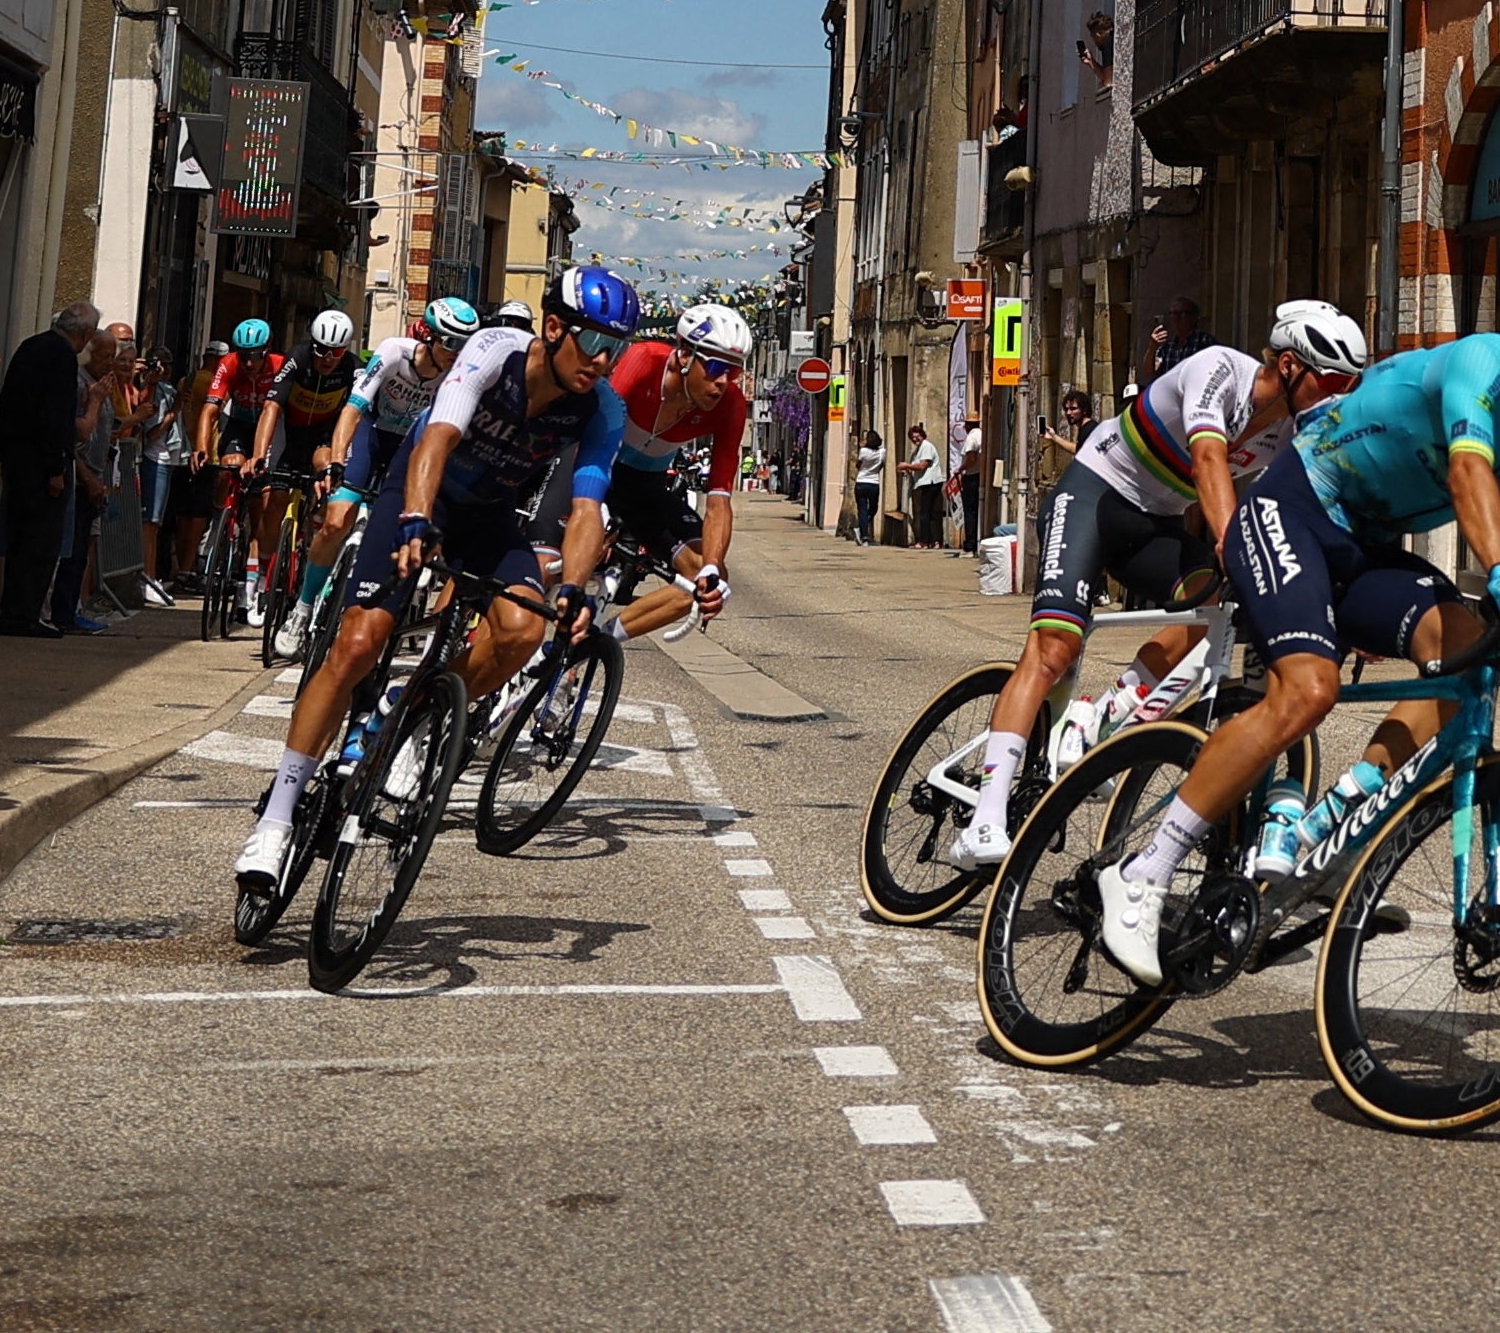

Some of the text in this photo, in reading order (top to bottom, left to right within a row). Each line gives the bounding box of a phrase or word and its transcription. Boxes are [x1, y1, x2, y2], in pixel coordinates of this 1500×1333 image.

[1043, 493, 1074, 581] deceuninck
[1239, 505, 1267, 596] QAZAQSTAN
[1257, 497, 1301, 584] ASTANA
[1295, 736, 1437, 877] Wilier
